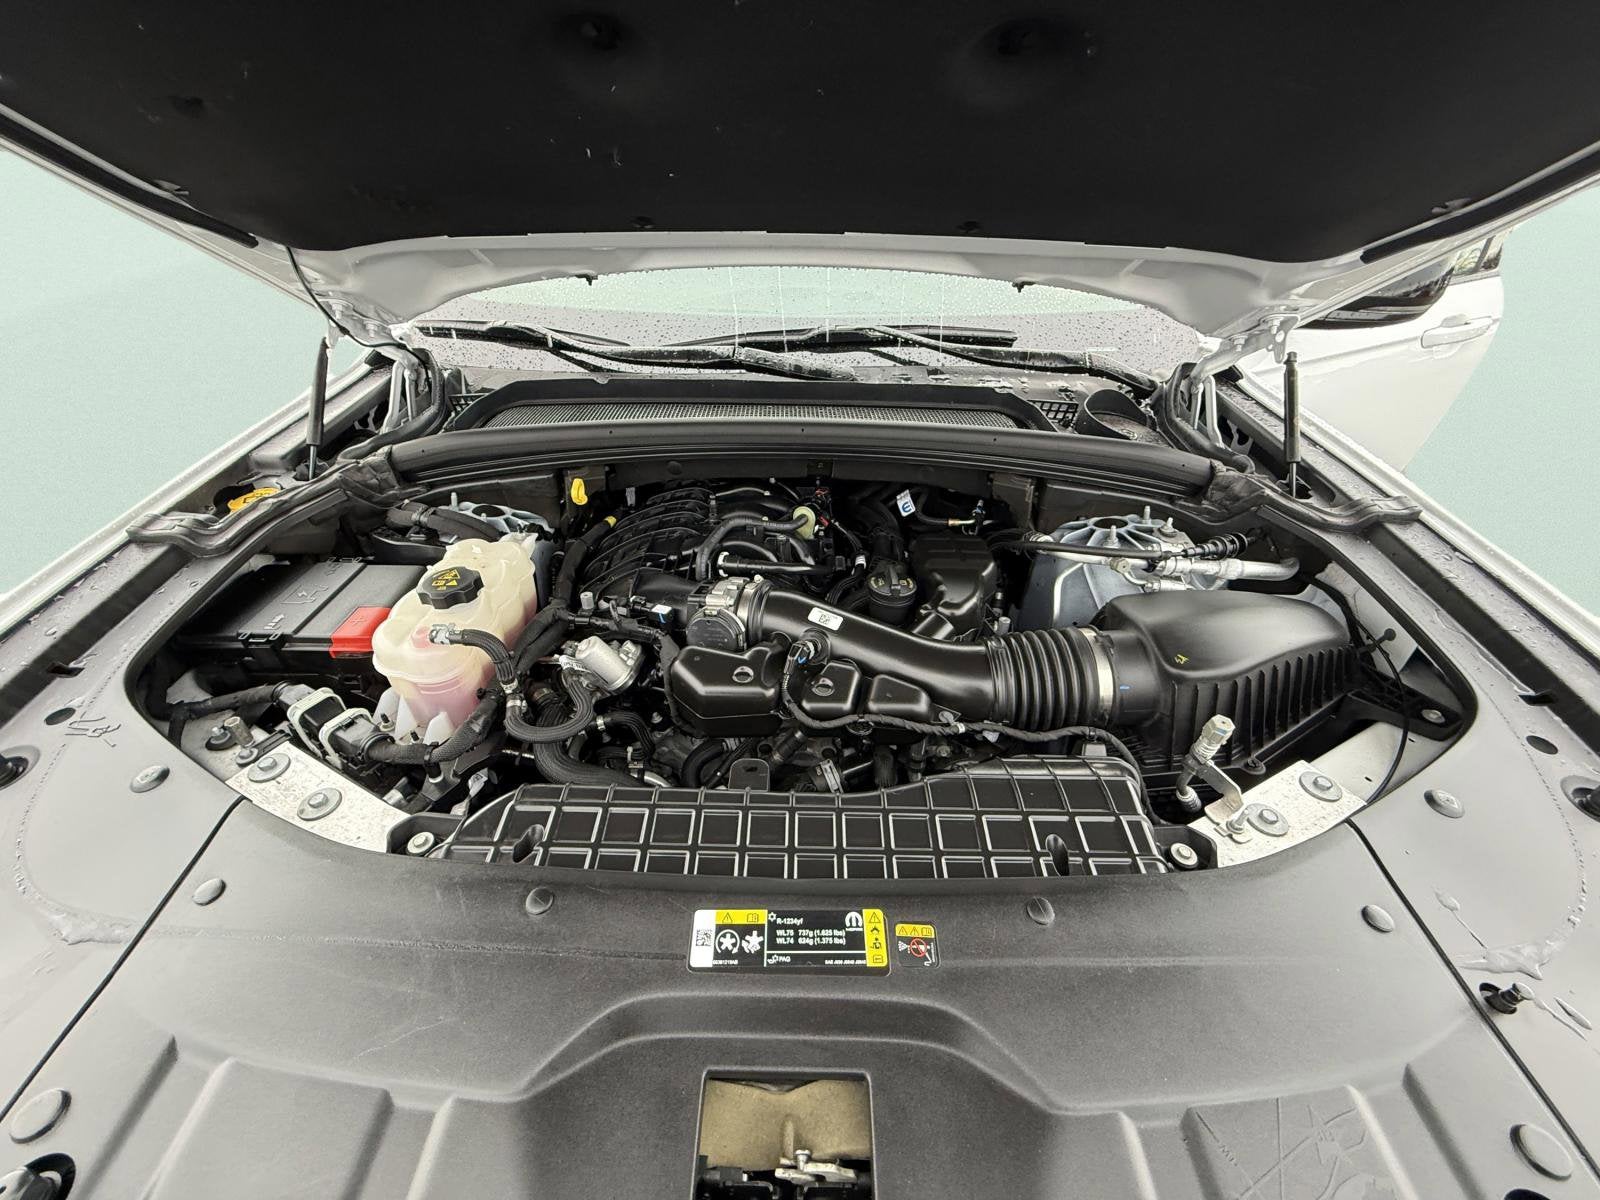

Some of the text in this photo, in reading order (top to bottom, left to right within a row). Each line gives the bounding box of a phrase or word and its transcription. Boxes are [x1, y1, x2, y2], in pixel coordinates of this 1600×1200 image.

[776, 918, 804, 926] R-1234yf
[798, 929, 814, 938] 737g
[833, 929, 846, 937] lbs)
[833, 937, 846, 945] lbs)
